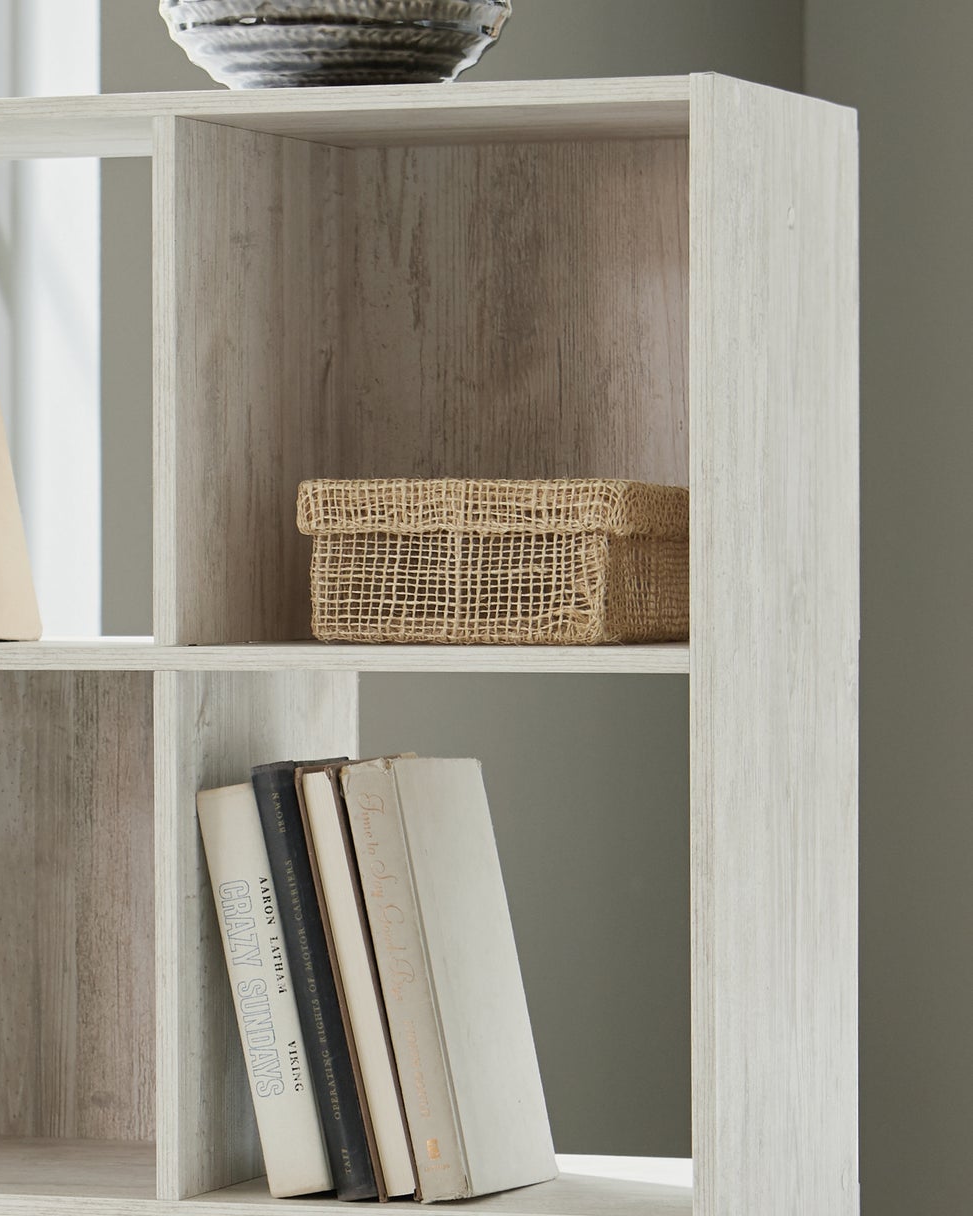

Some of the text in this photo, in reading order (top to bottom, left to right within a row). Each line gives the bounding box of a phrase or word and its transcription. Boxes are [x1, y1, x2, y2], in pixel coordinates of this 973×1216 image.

[272, 792, 285, 833] BROWN
[359, 793, 384, 838] Time
[284, 859, 302, 921] CARRIERS
[369, 860, 397, 899] Say
[259, 876, 287, 994] AARON LATHAM
[298, 927, 312, 970] MOTOR
[219, 879, 285, 1098] CRAZY SUNDAYS
[307, 978, 317, 993] OF
[311, 998, 327, 1043] RIGHTS
[287, 1040, 304, 1092] VIKING
[321, 1049, 340, 1120] OPERATING
